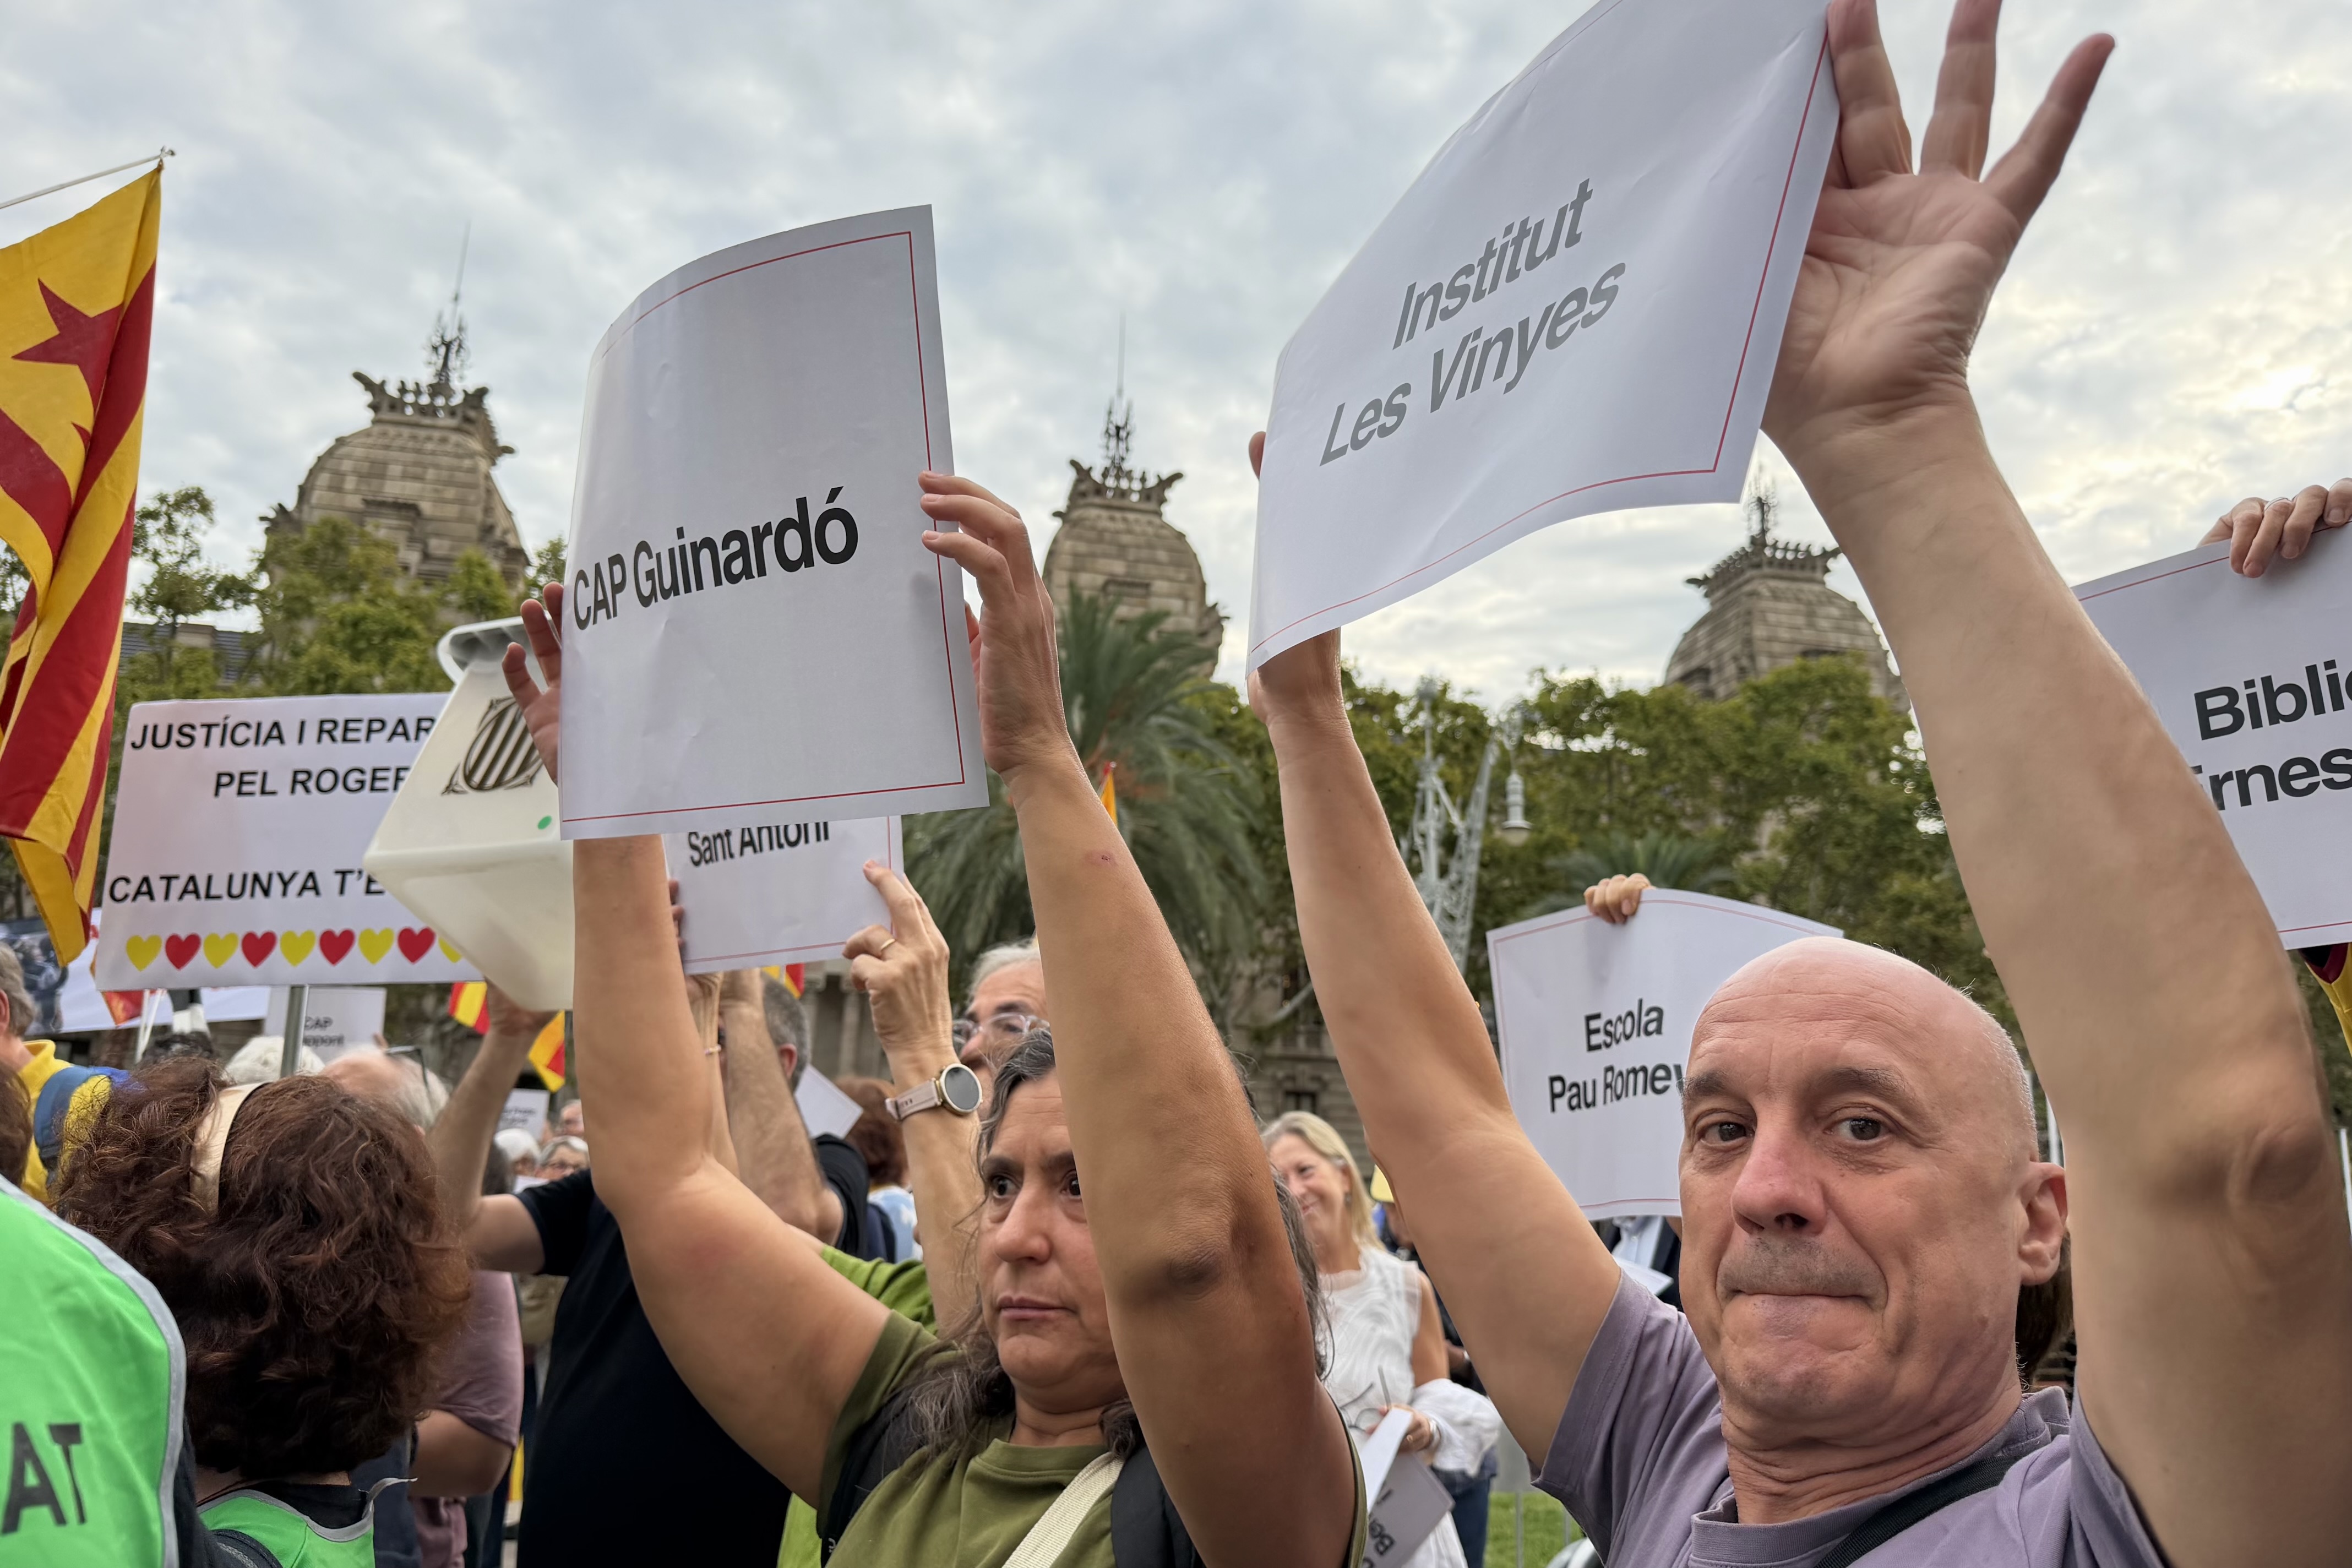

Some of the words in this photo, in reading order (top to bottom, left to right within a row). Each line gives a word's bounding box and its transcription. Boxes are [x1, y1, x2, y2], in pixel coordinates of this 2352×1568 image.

[1392, 177, 1594, 351] Institut
[1319, 383, 1412, 467] Les
[1430, 262, 1626, 413] Vinyes
[574, 553, 627, 630] CAP
[633, 486, 858, 608] Guinardó
[2193, 659, 2352, 741] Bibli
[130, 715, 285, 750] JUSTÍCIA
[297, 720, 306, 745] I
[214, 771, 278, 798] PEL
[2189, 748, 2352, 812] rnes
[688, 829, 735, 867] Sant
[108, 870, 322, 903] CATALUNYA
[1585, 998, 1664, 1052] Escola
[1548, 1075, 1596, 1113] Pau
[1, 1421, 86, 1537] AT
